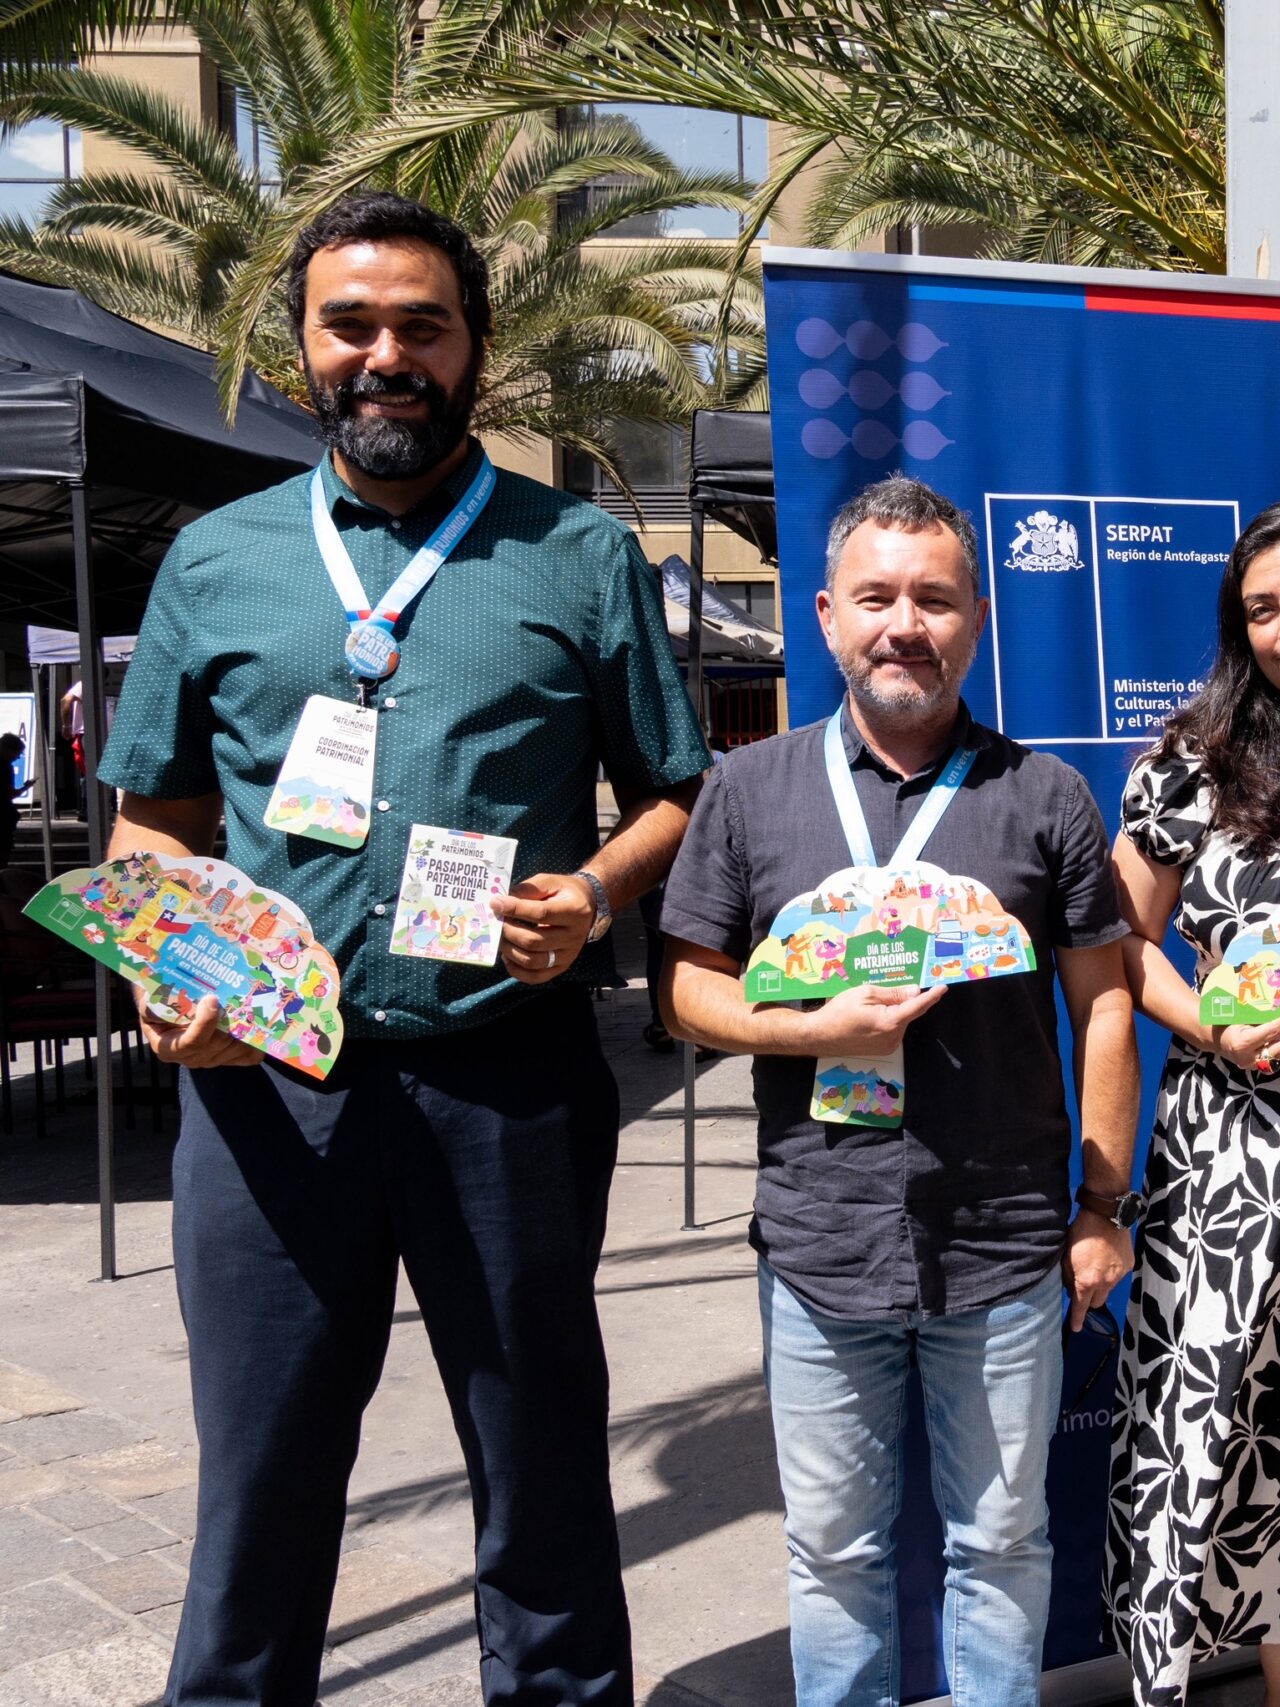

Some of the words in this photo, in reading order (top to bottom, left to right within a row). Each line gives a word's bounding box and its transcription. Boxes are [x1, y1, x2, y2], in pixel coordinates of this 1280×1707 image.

[1106, 524, 1173, 543] SERPAT
[1107, 548, 1146, 563] Región
[1148, 549, 1162, 561] de
[1164, 550, 1230, 565] Antofagasta
[1113, 679, 1184, 693] Ministerio
[1187, 679, 1204, 692] de
[1115, 697, 1175, 711] Culturas,
[1115, 716, 1124, 731] y
[1128, 714, 1141, 727] el
[315, 745, 365, 766] PATRIMONIAL
[441, 844, 484, 859] PATRIMONIOS
[429, 858, 489, 879] PASAPORTE
[426, 871, 487, 891] PATRIMONIAL
[434, 884, 448, 898] DE
[451, 887, 476, 902] CHILE
[192, 934, 209, 951] DÍA
[207, 942, 223, 958] DE
[219, 950, 238, 967] LOS
[867, 943, 878, 955] DÍA
[880, 943, 889, 954] DE
[891, 941, 904, 953] LOS
[167, 937, 245, 988] PATRIMONIOS
[854, 951, 919, 969] PATRIMONIOS
[179, 961, 192, 971] en
[192, 966, 220, 986] verano
